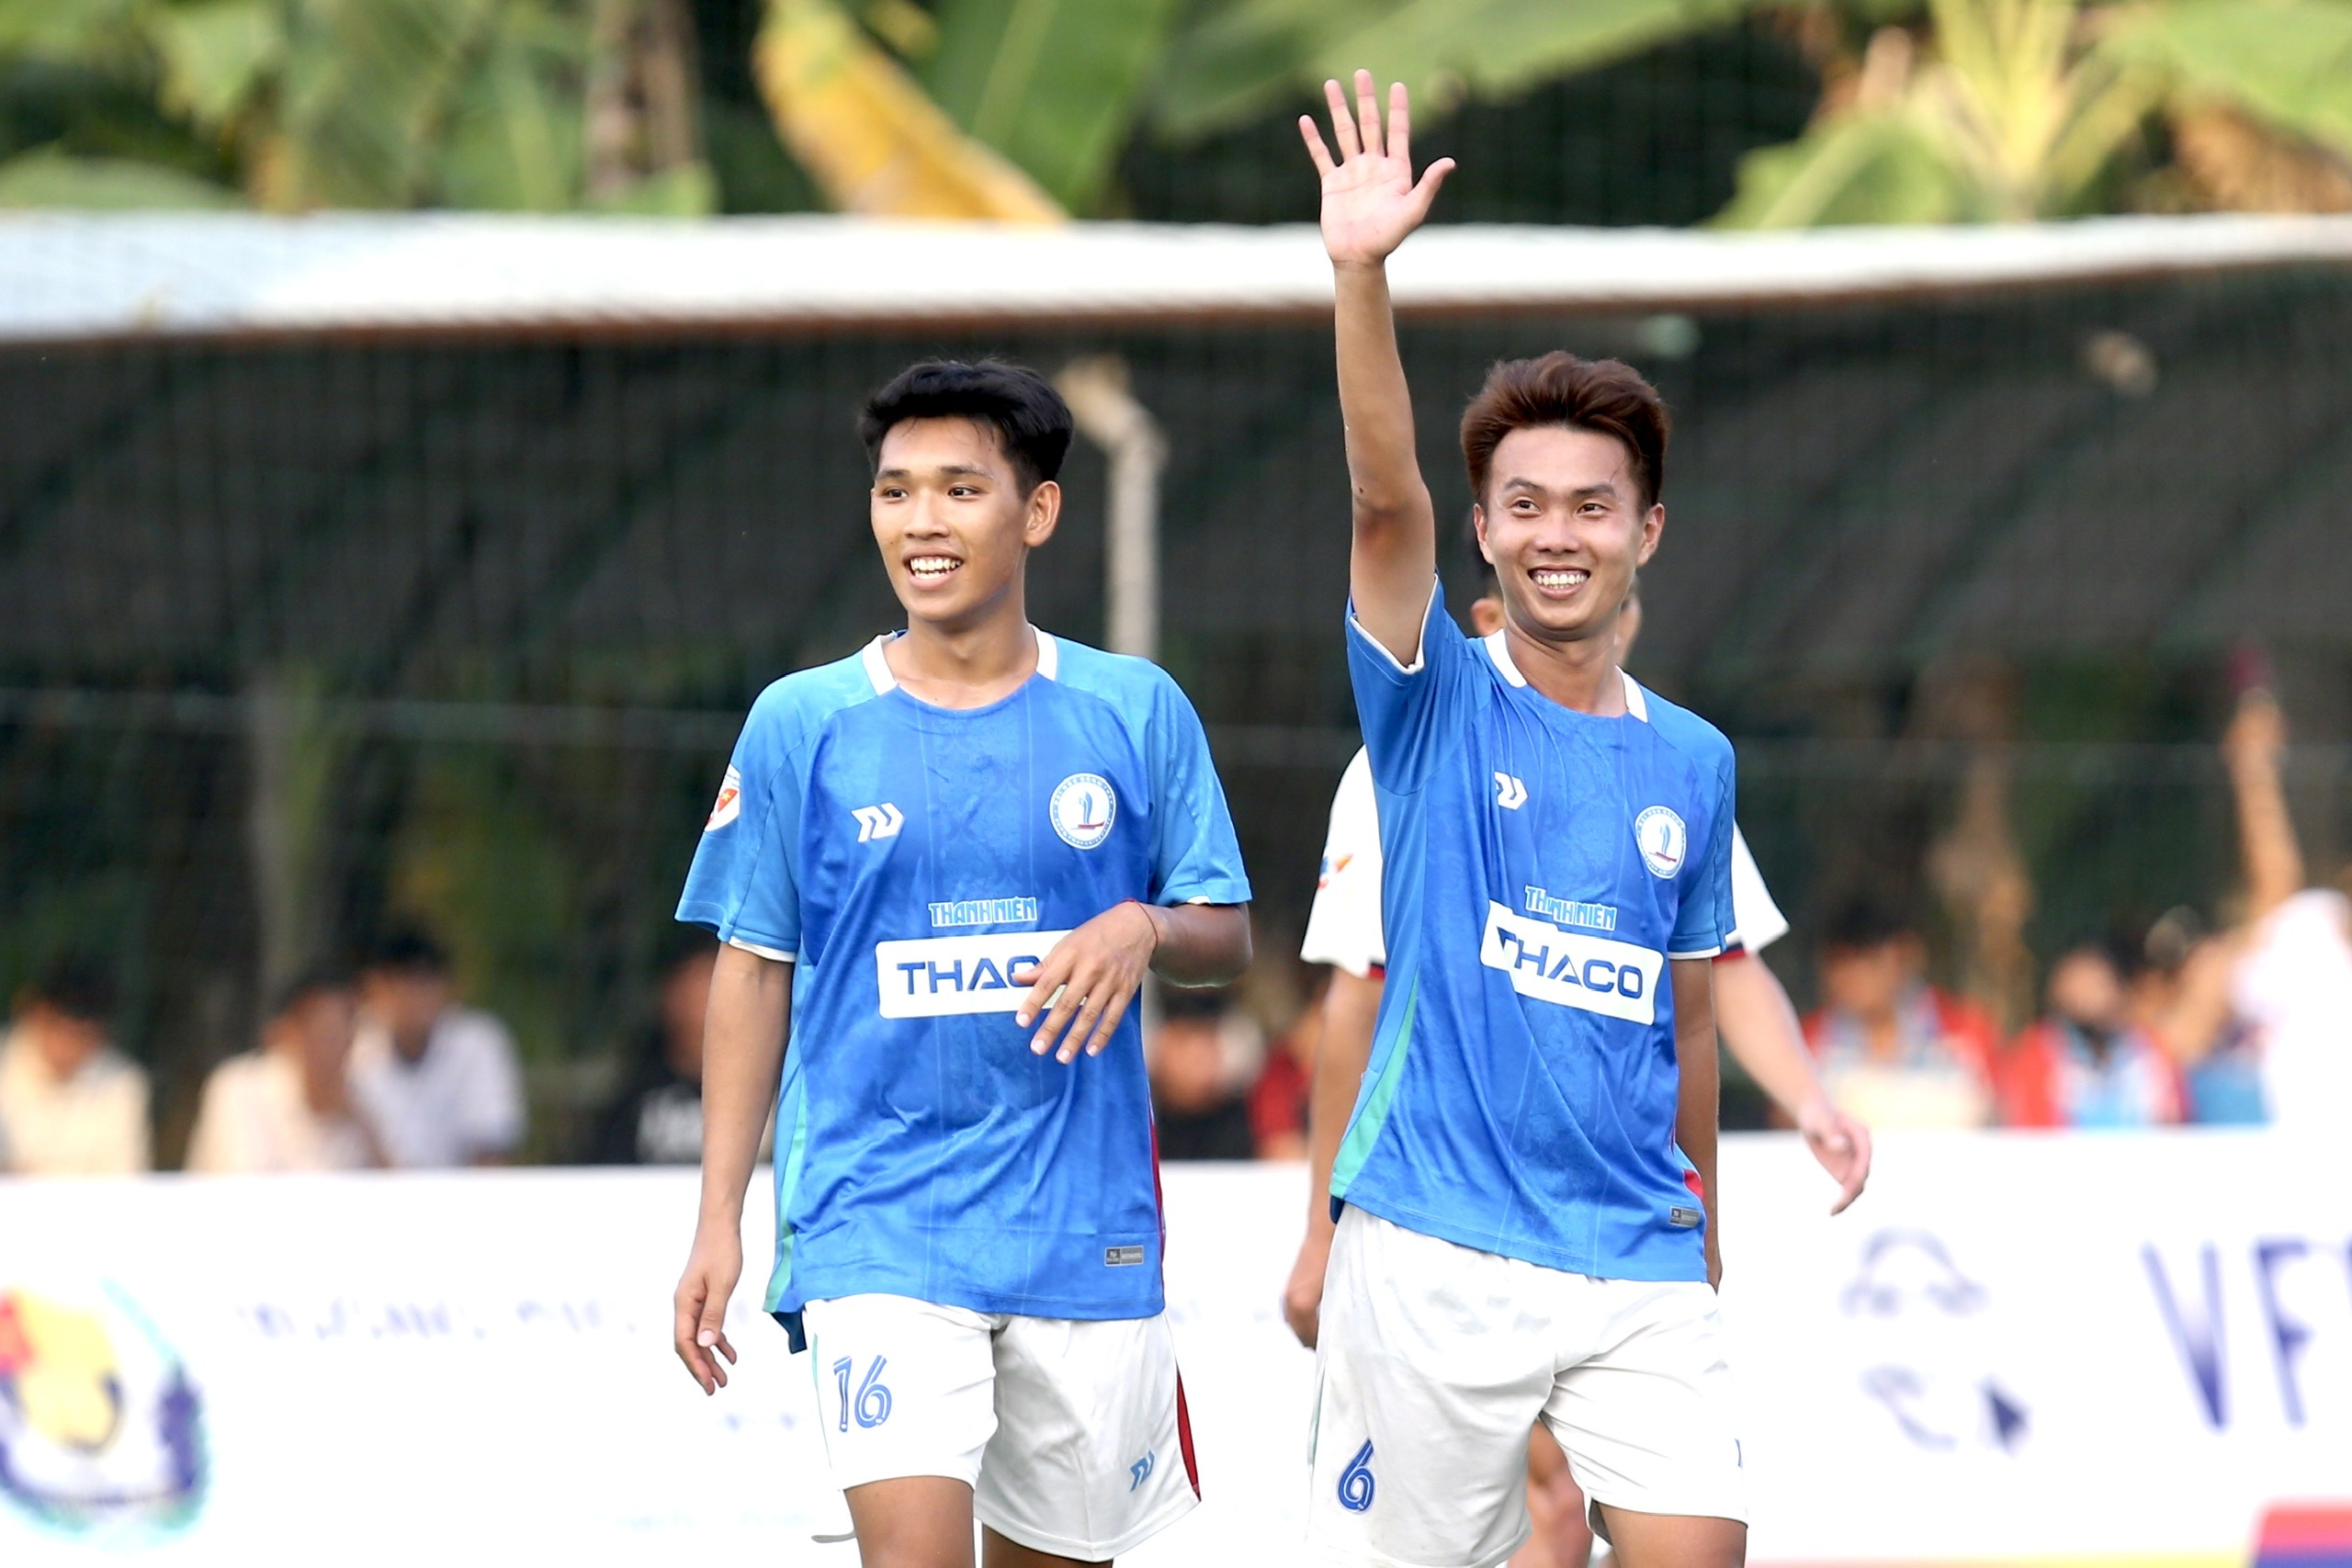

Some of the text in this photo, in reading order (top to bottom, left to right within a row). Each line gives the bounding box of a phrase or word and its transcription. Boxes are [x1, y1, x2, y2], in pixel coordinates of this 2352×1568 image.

[928, 900, 992, 927] THANH
[897, 955, 1042, 995] THAC
[2139, 1234, 2352, 1433] VF
[833, 1355, 892, 1432] 16
[1338, 1437, 1374, 1512] 6
